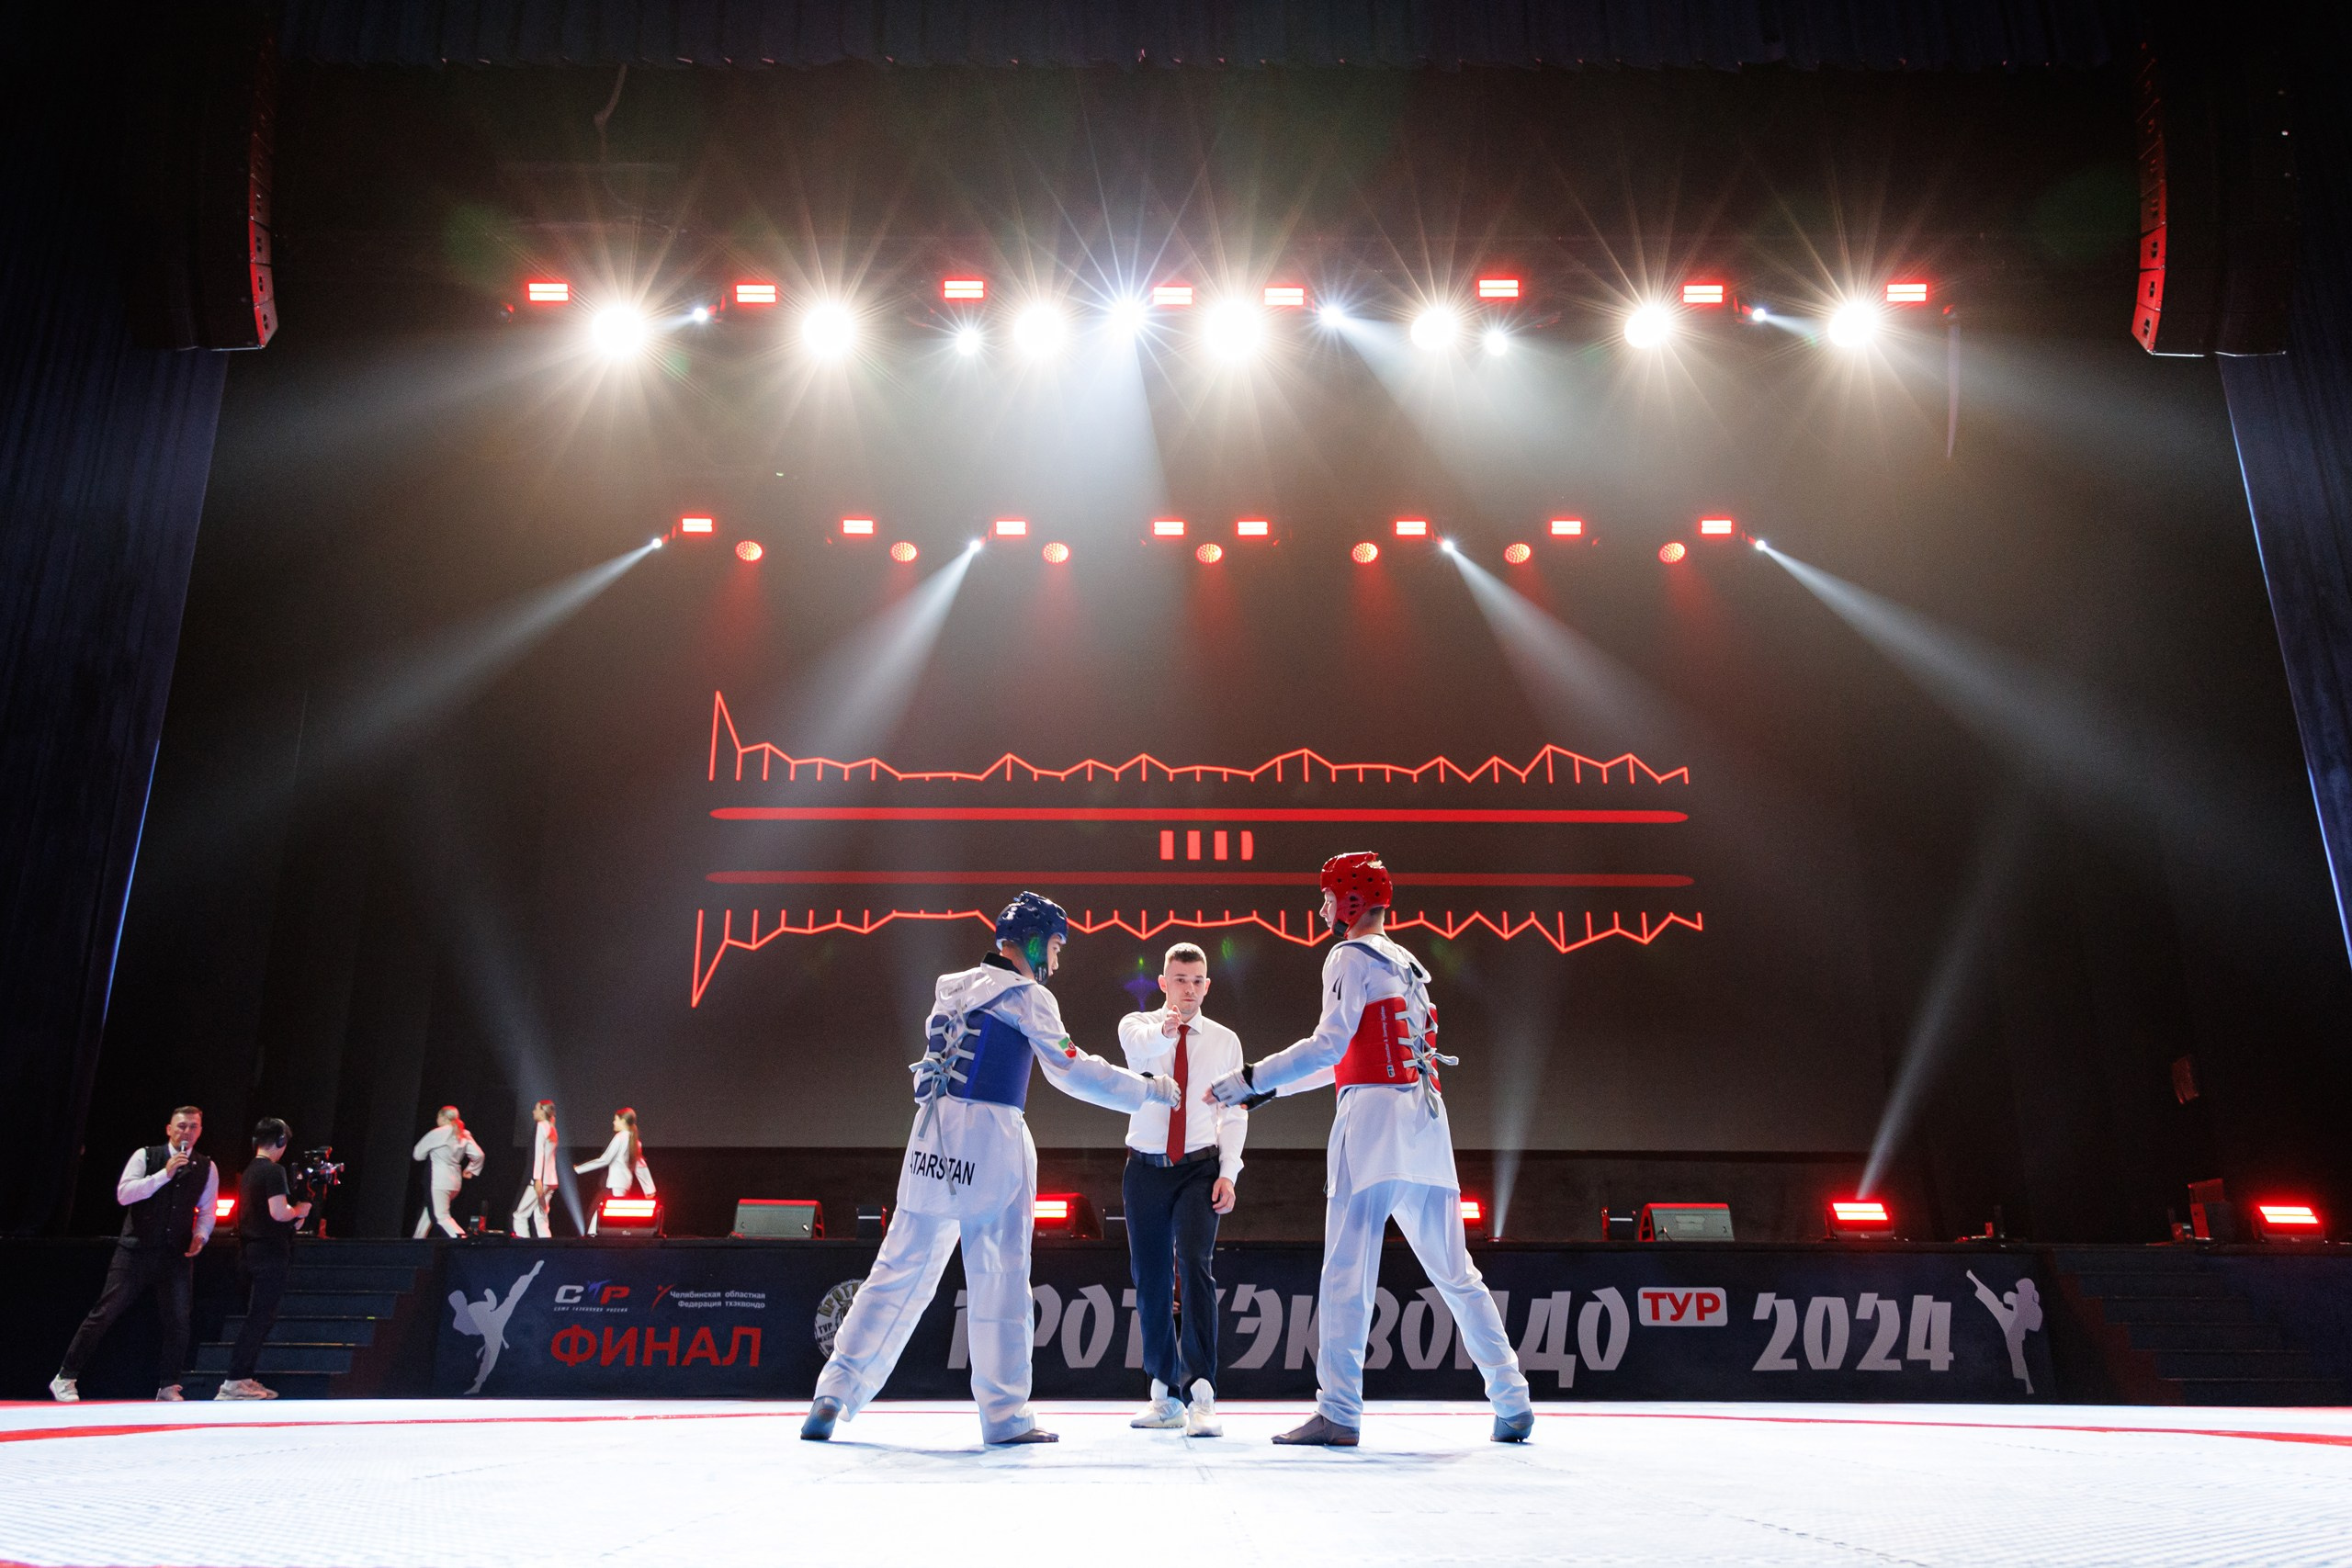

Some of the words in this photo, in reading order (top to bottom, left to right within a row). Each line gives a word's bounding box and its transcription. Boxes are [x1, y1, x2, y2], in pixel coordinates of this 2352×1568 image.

[910, 1150, 975, 1186] TARSTAN
[670, 1291, 721, 1299] Челябинская
[725, 1290, 765, 1299] областная
[678, 1300, 721, 1308] Федерация
[1642, 1292, 1721, 1321] ТУР
[551, 1325, 762, 1367] ФИНАЛ
[1752, 1292, 1954, 1371] 2024
